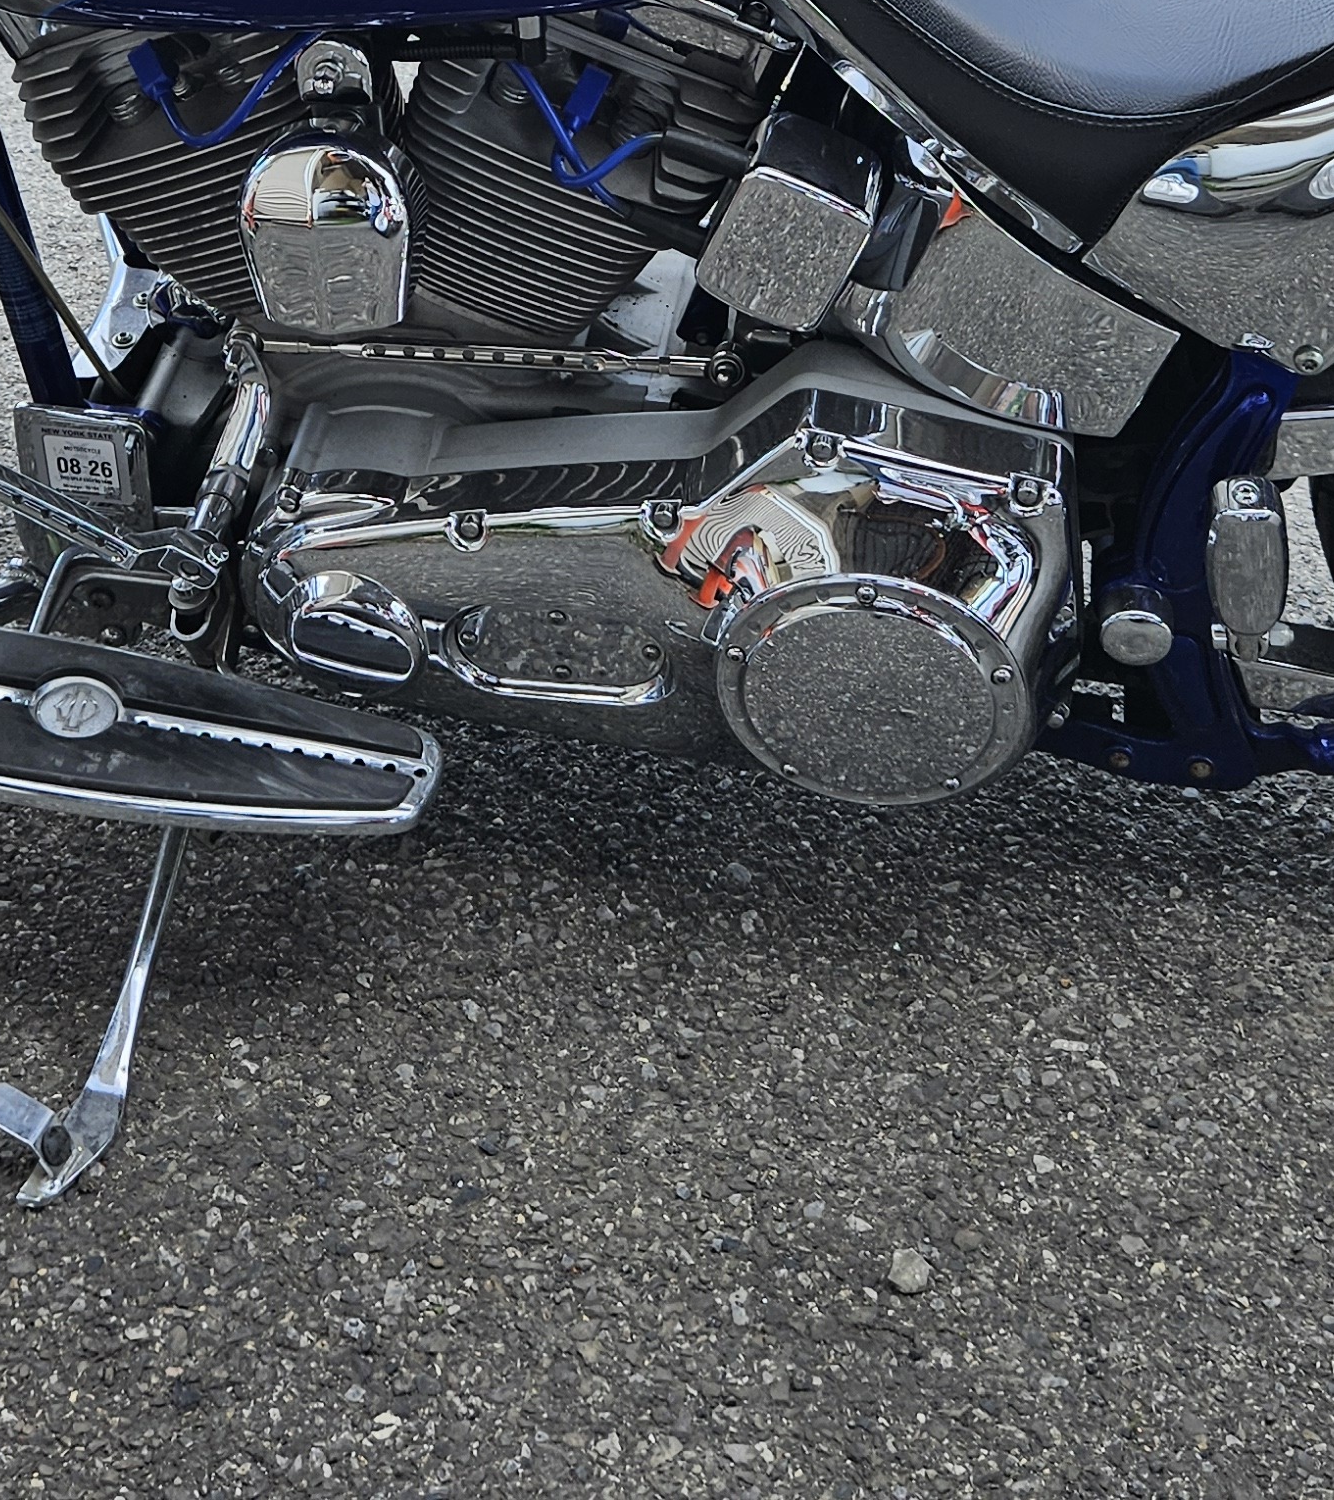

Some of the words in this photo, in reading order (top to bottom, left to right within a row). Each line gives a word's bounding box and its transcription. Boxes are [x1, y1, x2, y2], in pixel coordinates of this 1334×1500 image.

[41, 427, 60, 435] NEW
[61, 429, 85, 437] YORK
[87, 431, 113, 440] STATE
